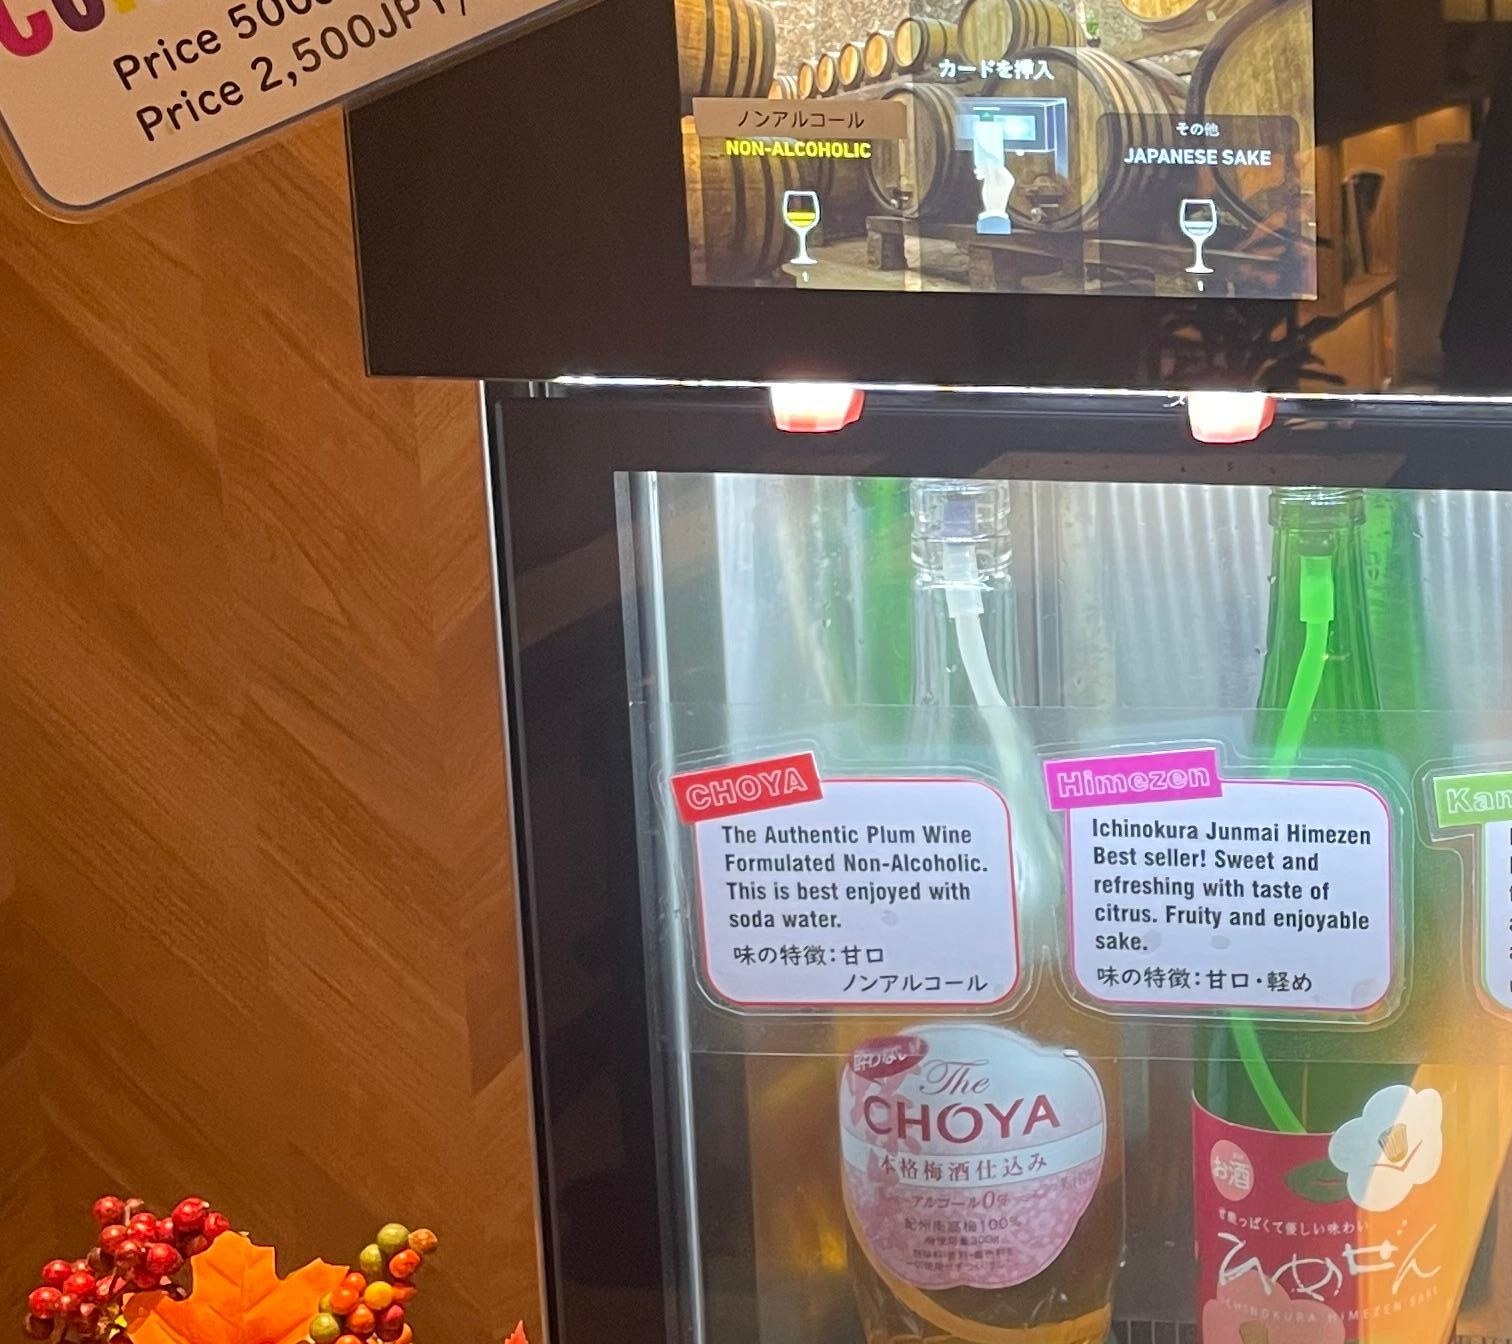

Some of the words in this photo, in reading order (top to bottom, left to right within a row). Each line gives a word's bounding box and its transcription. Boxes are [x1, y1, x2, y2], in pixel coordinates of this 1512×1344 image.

[112, 29, 222, 91] Price
[136, 80, 243, 141] Price
[736, 109, 865, 130] ノンアルコール
[1175, 121, 1220, 138] その他
[725, 138, 872, 158] NON-ALCOHOLIC
[1124, 147, 1218, 165] JAPANESE
[1222, 148, 1271, 166] SAKE
[686, 767, 808, 811] CHOYA
[1057, 766, 1211, 799] Himezen
[765, 826, 859, 844] Authentic
[867, 825, 916, 844] Plum
[923, 825, 972, 844] Wine
[1092, 819, 1199, 840] Ichinokura
[1206, 822, 1279, 842] Junmai
[1287, 824, 1371, 844] Himezen
[725, 854, 835, 873] Formulated
[844, 854, 988, 873] Non-Alcoholic.
[1094, 847, 1136, 866] Best
[1144, 848, 1206, 867] seller!
[1214, 850, 1275, 870] Sweet
[726, 882, 767, 901] This
[798, 882, 839, 901] best
[846, 882, 921, 905] enjoyed
[929, 882, 970, 900] with
[1094, 876, 1194, 900] refreshing
[1203, 879, 1244, 898] with
[1252, 881, 1302, 899] taste
[729, 910, 775, 928] soda
[1165, 906, 1221, 929] Fruity
[1274, 910, 1369, 932] enjoyable
[733, 944, 884, 966] 味の特徴：甘口
[842, 974, 988, 993] ノンアルコール
[1097, 967, 1312, 993] 味の特徴：甘口・軽め
[919, 1059, 991, 1096] The
[863, 1094, 1060, 1143] CHOYA
[880, 1152, 1047, 1182] 本格梅酒仕込み
[1213, 1157, 1252, 1191] お酒
[1328, 1304, 1401, 1323] HIMEZEN
